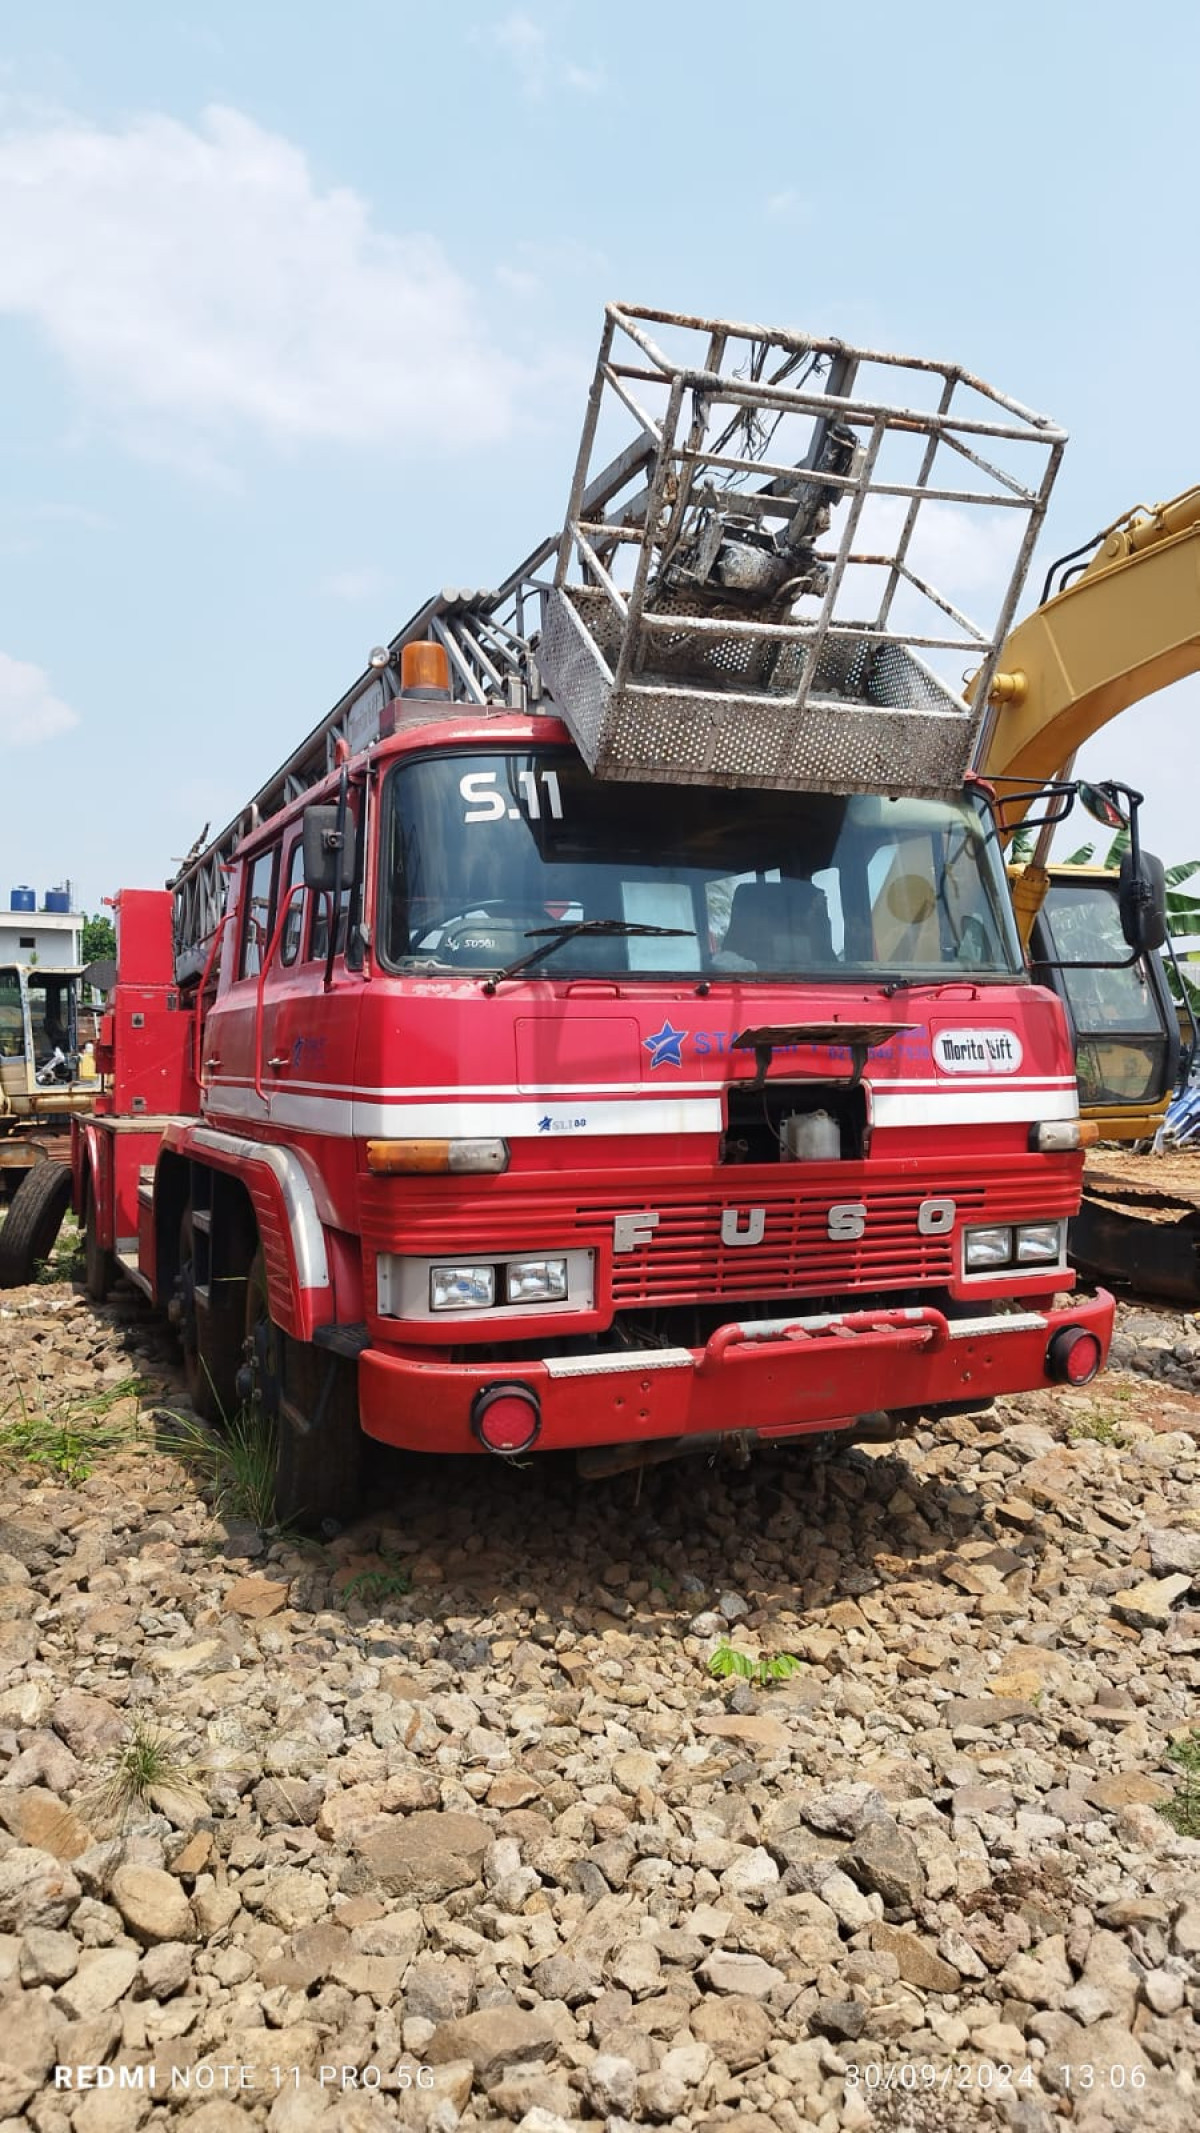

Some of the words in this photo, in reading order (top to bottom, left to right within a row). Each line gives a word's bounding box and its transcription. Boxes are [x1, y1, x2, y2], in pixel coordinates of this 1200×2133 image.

[460, 771, 563, 823] S.11
[941, 1038, 985, 1061] Morita
[614, 1200, 956, 1252] FUSO
